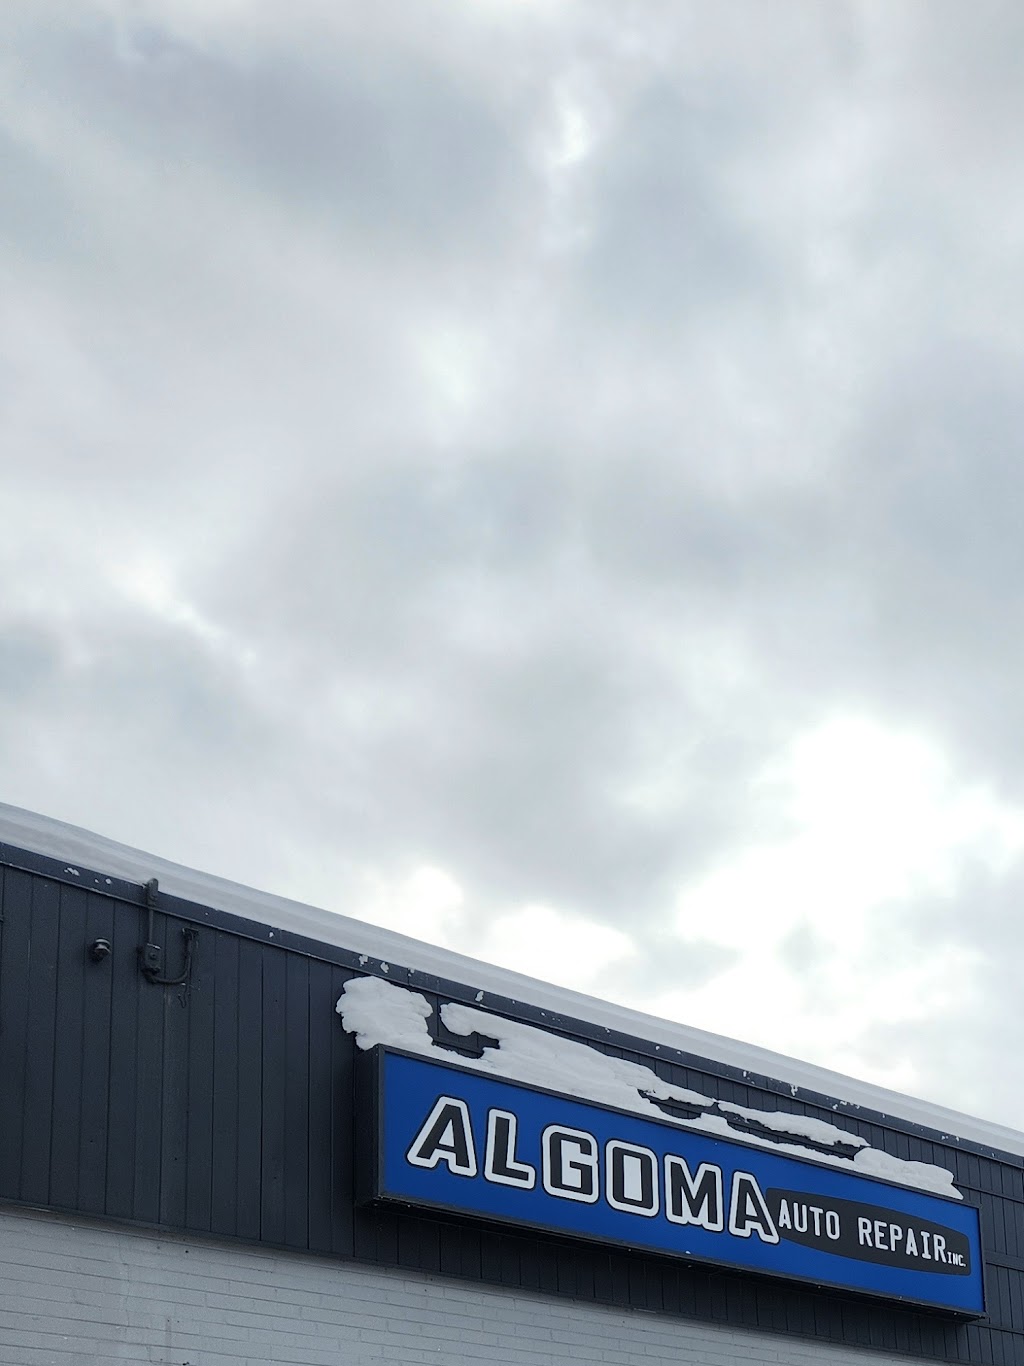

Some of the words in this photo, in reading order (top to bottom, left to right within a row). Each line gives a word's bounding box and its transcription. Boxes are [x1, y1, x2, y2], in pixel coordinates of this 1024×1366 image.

[406, 1095, 780, 1245] ALGOMA
[778, 1199, 841, 1240] AUTO
[857, 1217, 947, 1263] REPAIR
